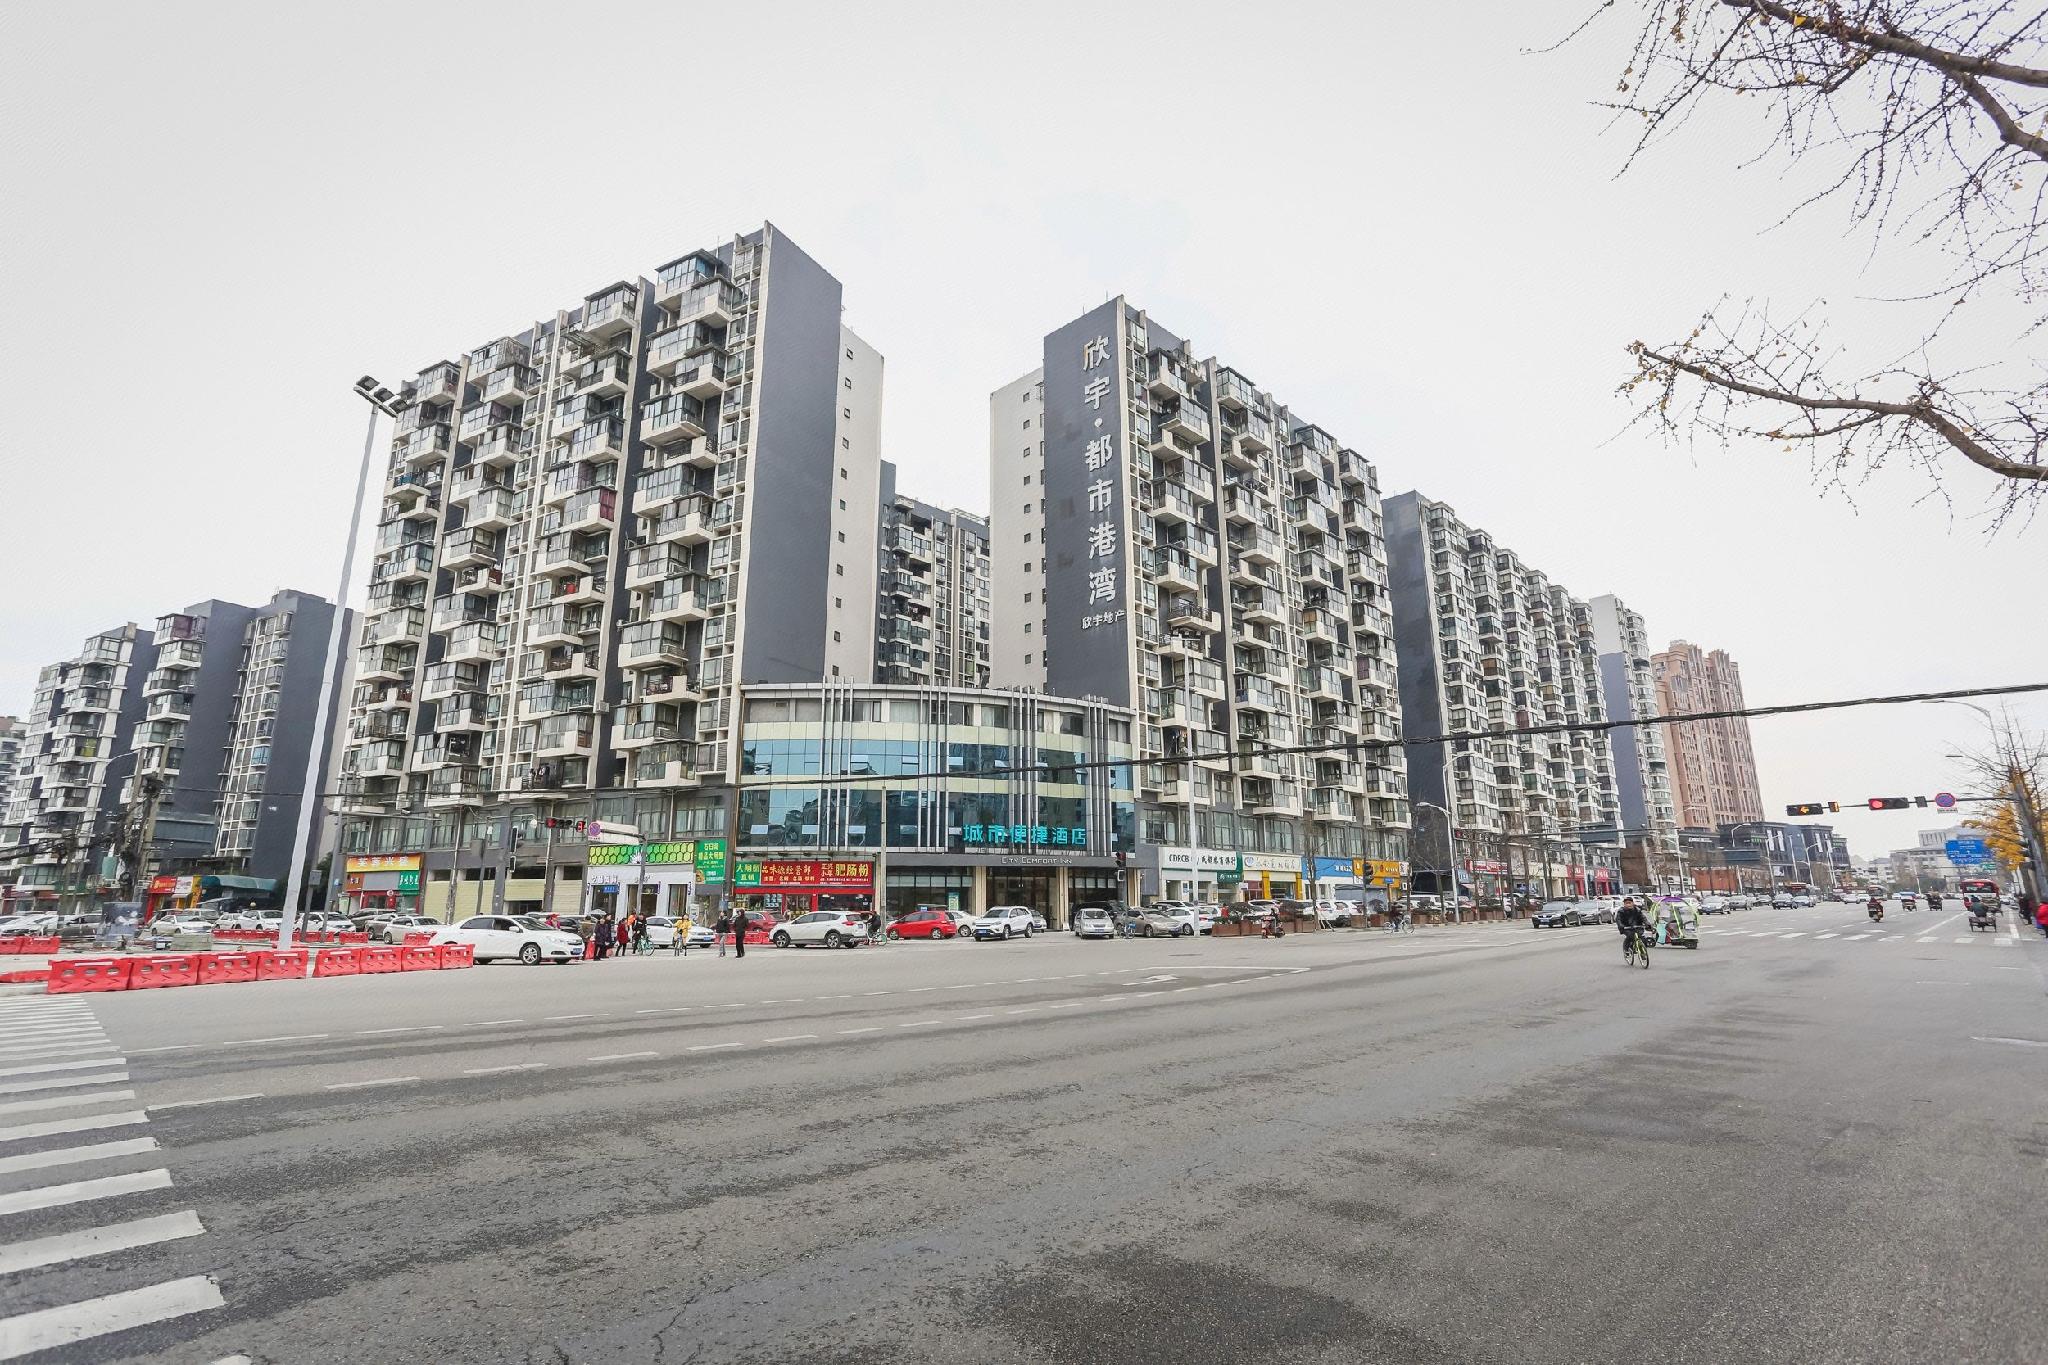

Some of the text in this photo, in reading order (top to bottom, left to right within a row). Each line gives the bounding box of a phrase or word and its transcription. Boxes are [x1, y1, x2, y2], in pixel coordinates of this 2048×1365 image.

[963, 824, 1086, 845] 城市便捷酒店
[835, 863, 869, 877] 肥肠粉
